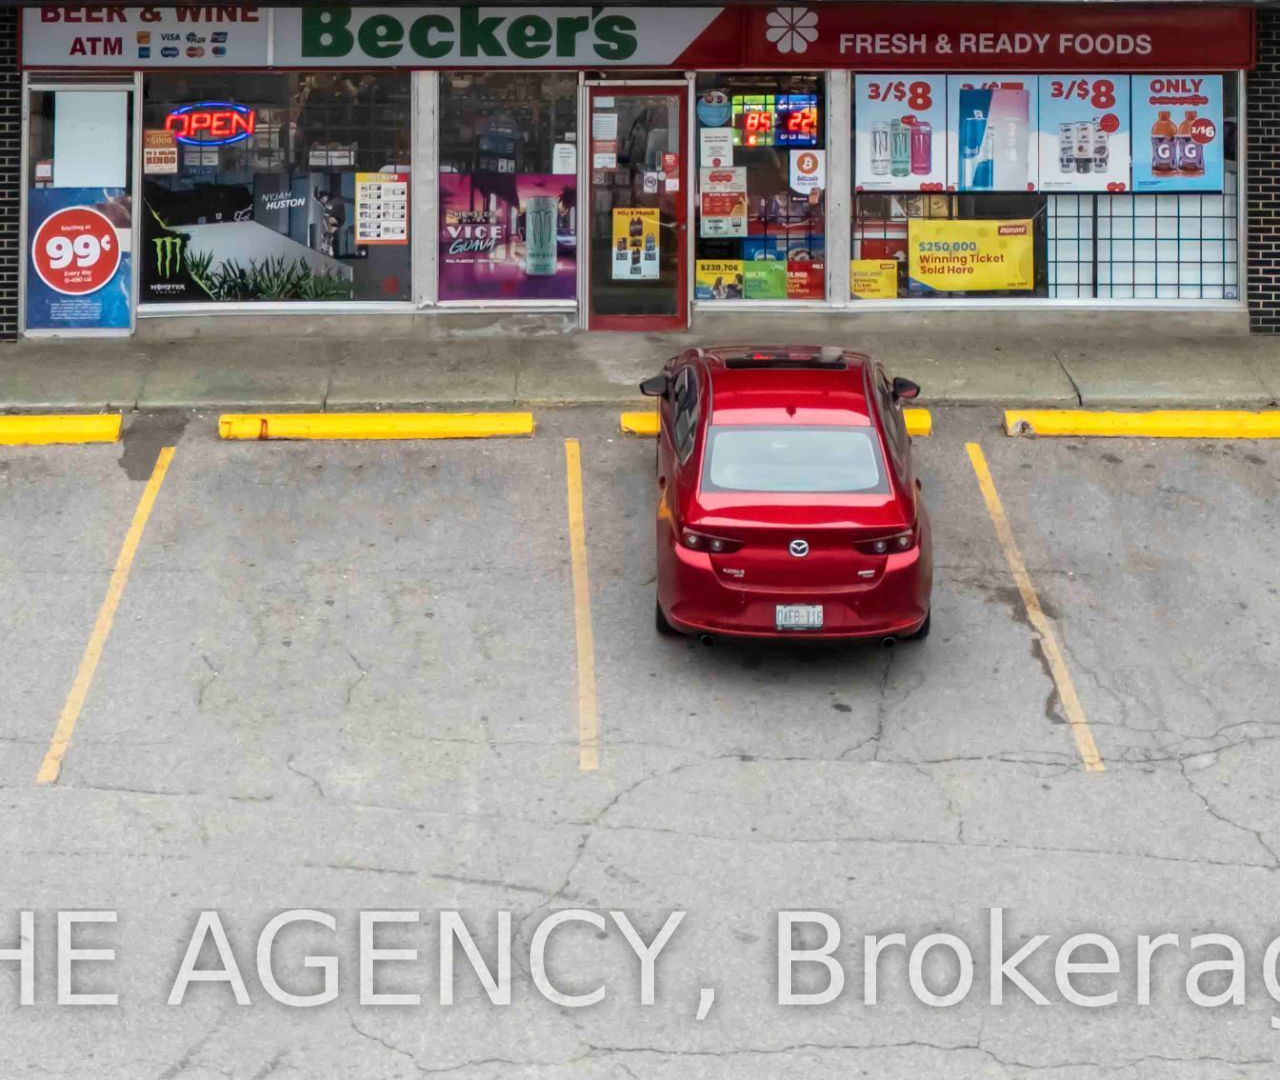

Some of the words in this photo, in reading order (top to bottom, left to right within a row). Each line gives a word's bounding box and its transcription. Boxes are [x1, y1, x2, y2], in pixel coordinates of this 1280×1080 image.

[40, 7, 128, 22] BEER
[139, 7, 162, 22] &
[174, 7, 259, 22] WINE
[160, 33, 180, 41] VISA
[302, 7, 638, 60] Becker's
[69, 37, 123, 55] ATM
[839, 33, 927, 55] FRESH
[934, 33, 953, 54] &
[959, 33, 1051, 54] READY
[1059, 33, 1152, 55] FOODS
[1150, 79, 1204, 93] ONLY
[868, 81, 933, 111] 3/$8
[1051, 79, 1116, 109] 3/$8
[164, 109, 256, 138] OPEN
[746, 112, 771, 133] 85
[1158, 144, 1171, 158] G
[1184, 144, 1198, 158] G
[261, 192, 292, 203] NYJAH
[266, 198, 306, 210] HUSTON
[447, 226, 502, 238] VICE
[449, 237, 497, 255] GUAVA
[919, 254, 968, 266] Winning
[969, 252, 1005, 264] Ticket
[920, 266, 945, 275] Sold
[947, 265, 974, 274] Here
